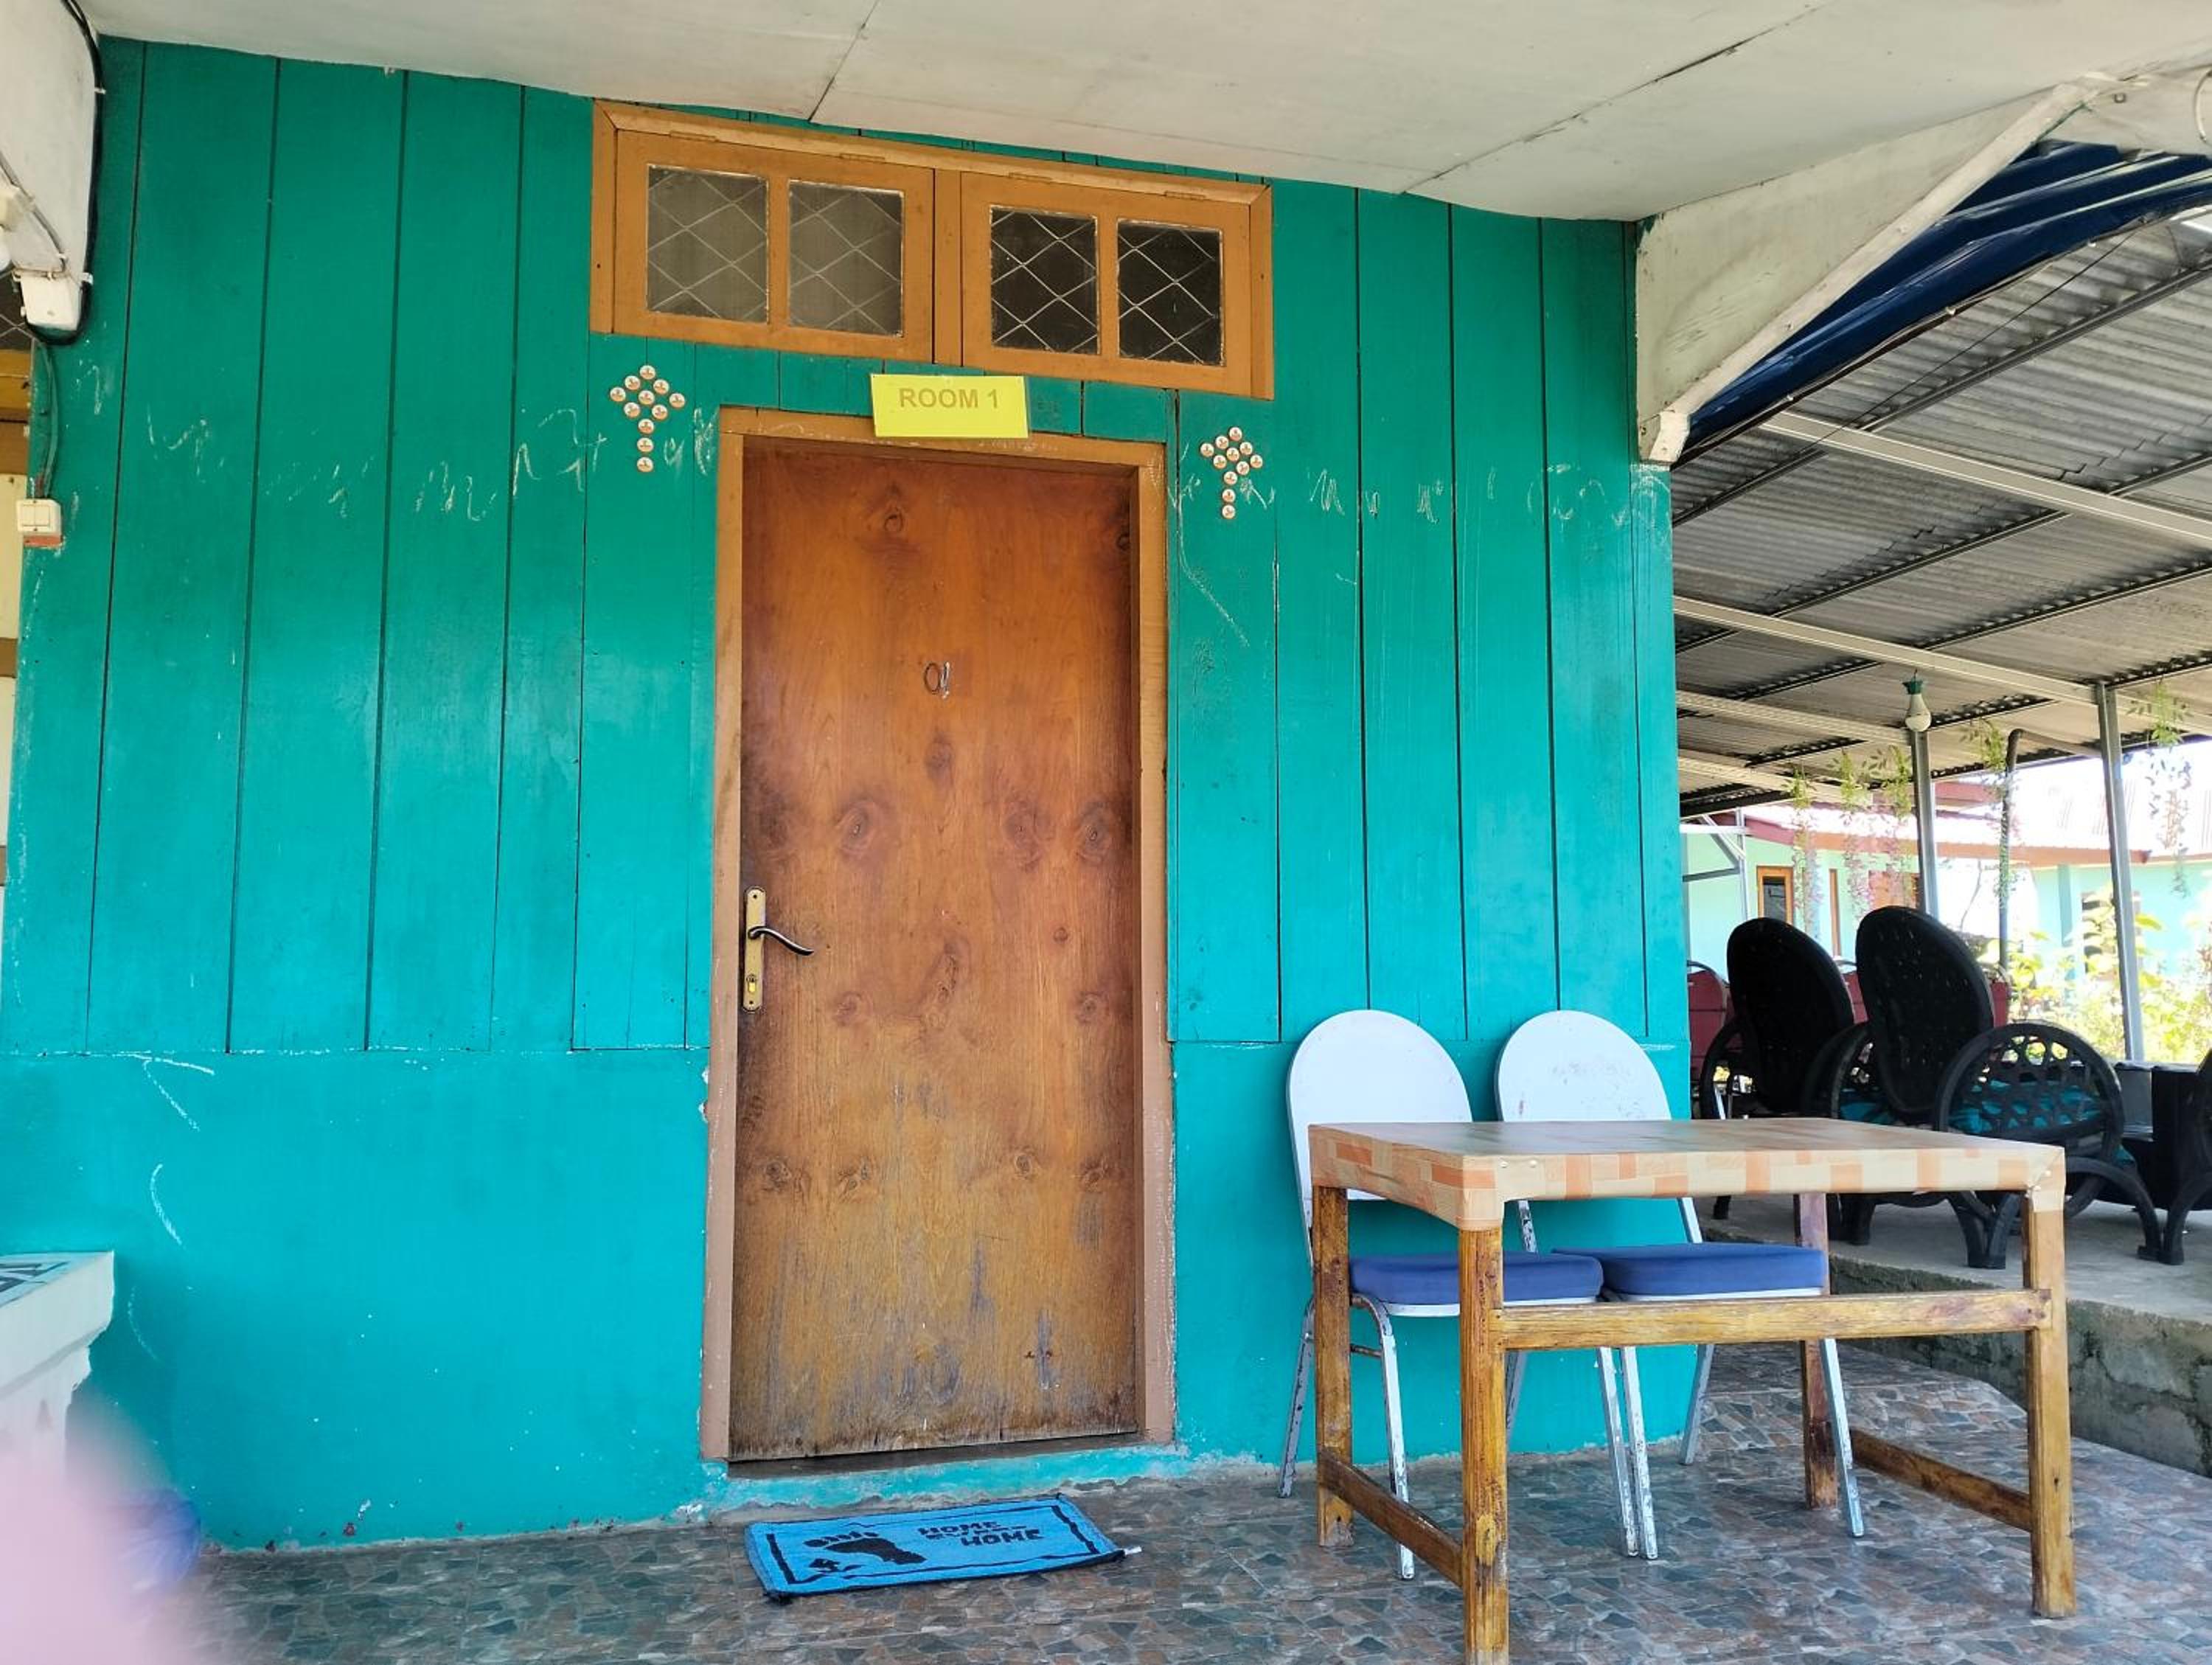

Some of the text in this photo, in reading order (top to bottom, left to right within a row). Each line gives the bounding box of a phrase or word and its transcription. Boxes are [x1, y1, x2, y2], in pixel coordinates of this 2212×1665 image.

[898, 387, 999, 409] ROOM 1
[960, 1529, 1045, 1546] HOME
